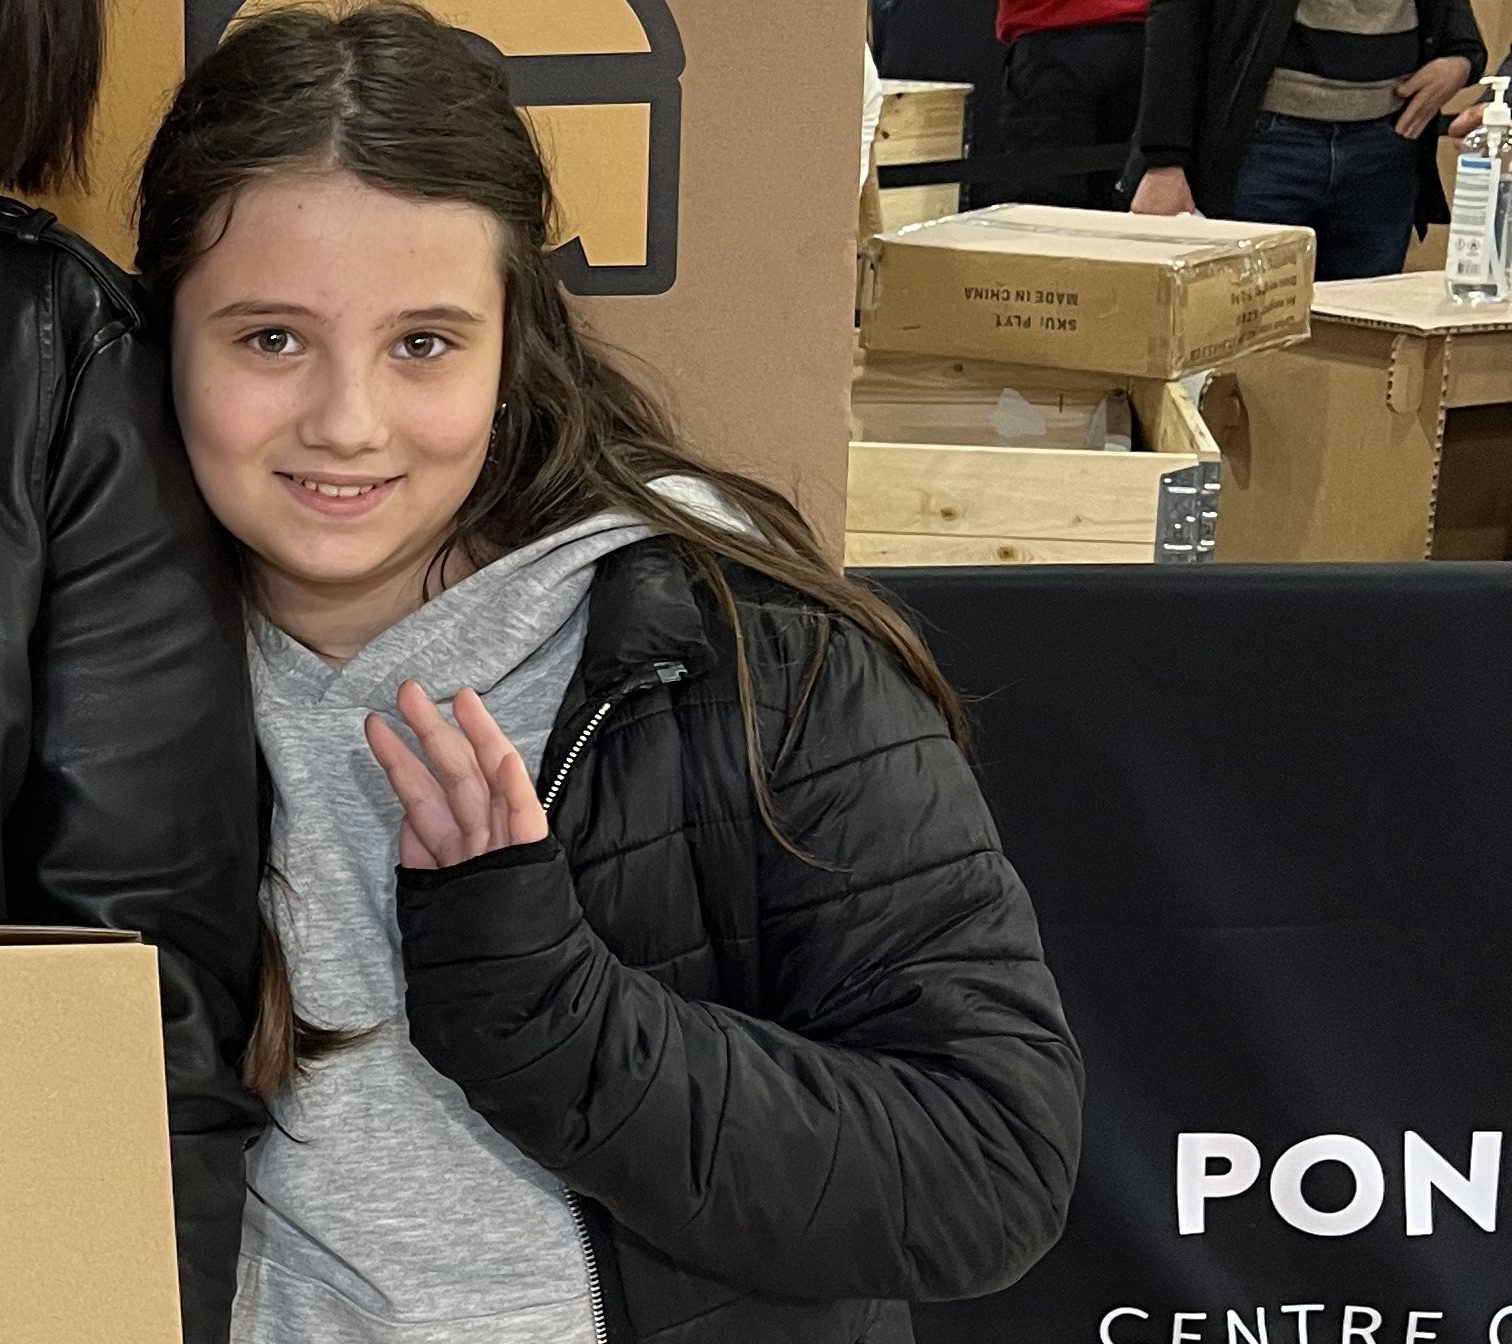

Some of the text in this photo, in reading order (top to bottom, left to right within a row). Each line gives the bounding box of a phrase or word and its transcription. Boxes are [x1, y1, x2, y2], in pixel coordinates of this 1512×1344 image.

[964, 287, 1079, 306] MADE IN CHINA
[1176, 1130, 1503, 1237] PON
